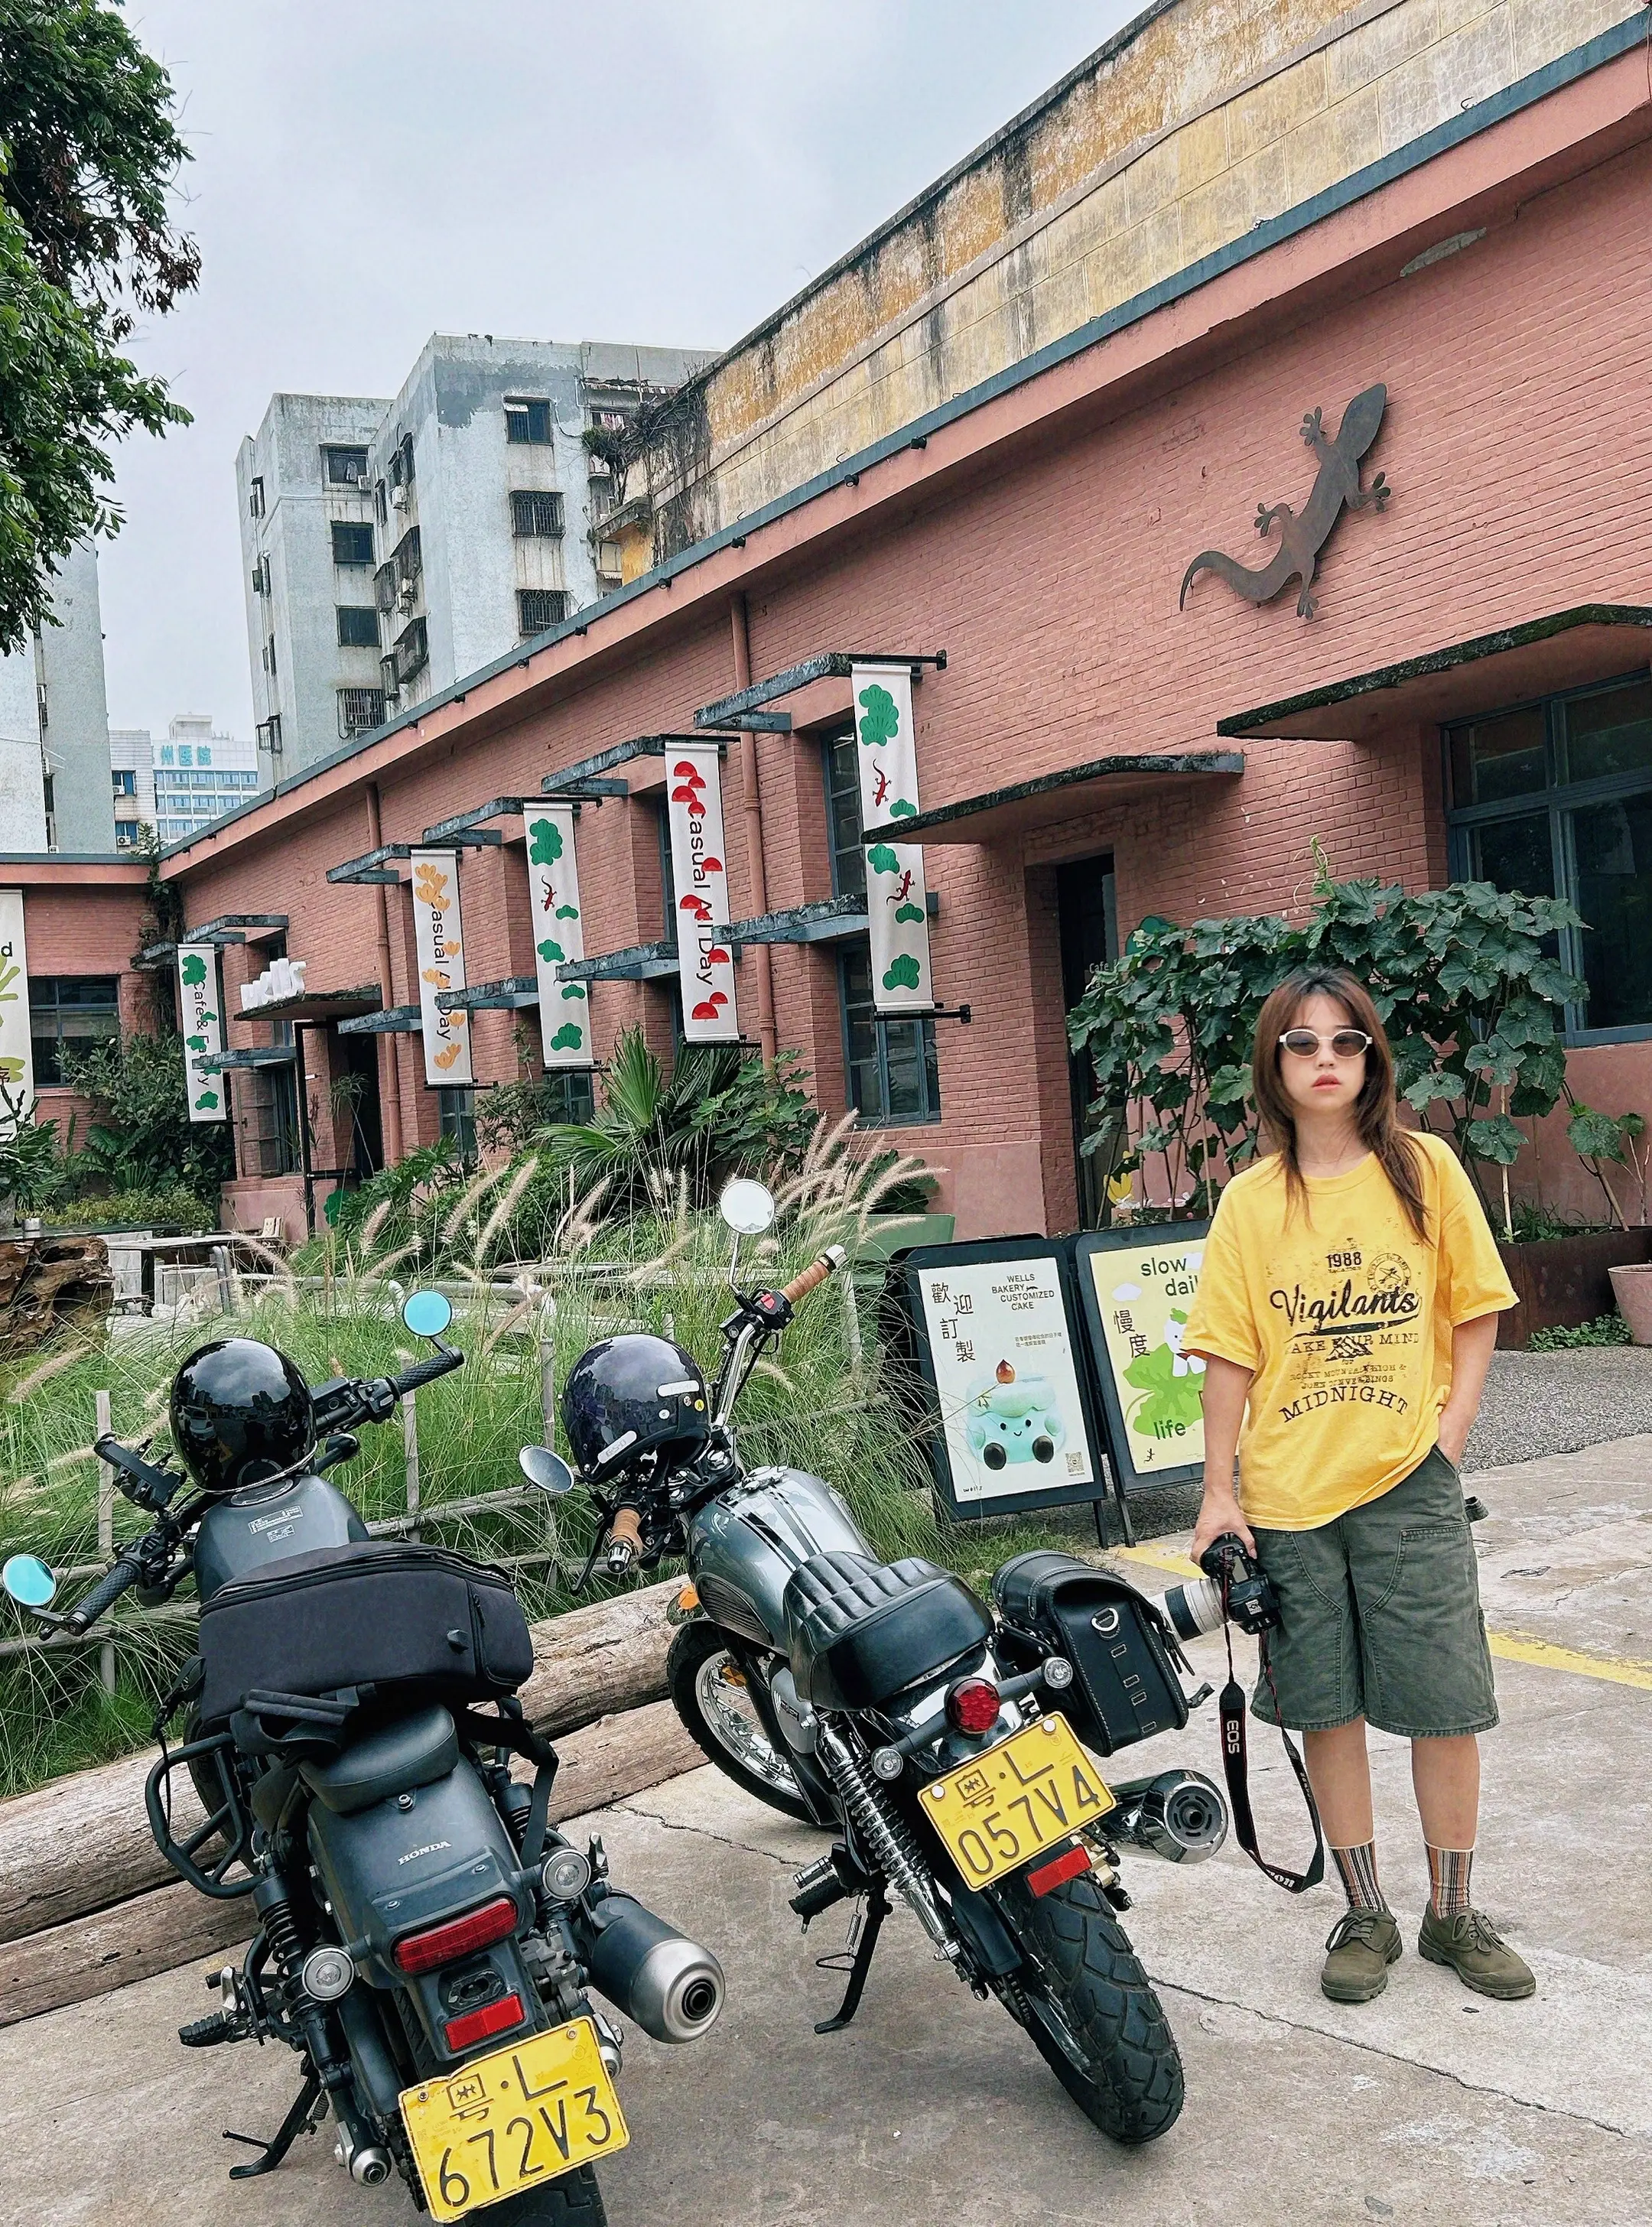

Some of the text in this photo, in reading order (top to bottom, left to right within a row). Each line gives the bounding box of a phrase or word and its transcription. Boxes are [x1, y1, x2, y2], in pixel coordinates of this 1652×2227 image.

[158, 744, 211, 766] 州医院
[430, 896, 450, 964] asual
[697, 938, 715, 987] Day
[197, 1019, 209, 1031] &
[1140, 1257, 1186, 1277] slow
[1325, 1252, 1362, 1268] 1988
[992, 1284, 1025, 1294] BAKERY
[1006, 1274, 1036, 1283] WELLS
[1165, 1276, 1199, 1296] dail
[1000, 1290, 1055, 1303] CUSTOMIZED
[1011, 1302, 1035, 1311] CAKE
[1270, 1279, 1420, 1331] Vigilants
[1114, 1309, 1150, 1359] 慢度
[1288, 1340, 1327, 1354] AKE
[1278, 1386, 1409, 1423] MIDNIGHT
[1153, 1419, 1186, 1440] life
[1226, 1719, 1241, 1754] EOS
[958, 1764, 1101, 1875] 057V4
[397, 1840, 452, 1866] HONDA
[439, 2086, 611, 2208] 672V3
